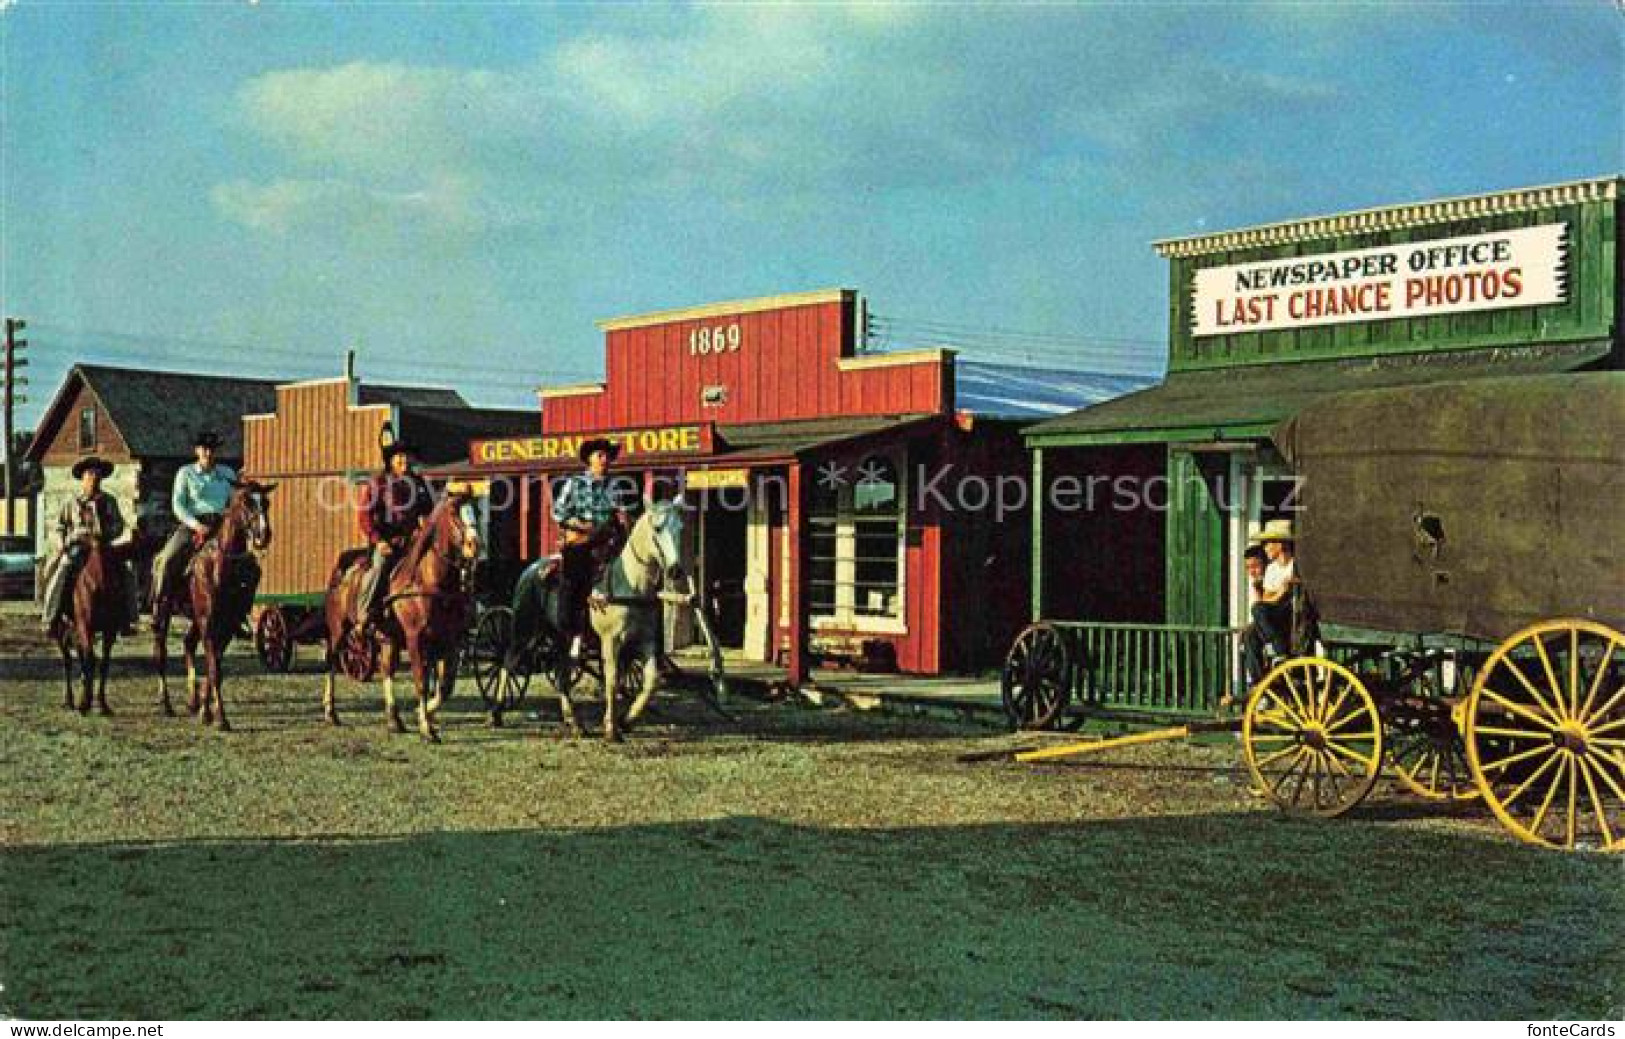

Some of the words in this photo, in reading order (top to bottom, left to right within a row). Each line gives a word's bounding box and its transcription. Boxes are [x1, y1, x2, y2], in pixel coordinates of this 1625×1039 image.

[1235, 252, 1398, 292] NEWSPAPER
[1408, 239, 1512, 272] OFFICE
[1215, 294, 1279, 326] LAST
[1288, 281, 1392, 319] CHANCE
[1406, 268, 1523, 309] PHOTOS
[689, 324, 742, 356] 1869
